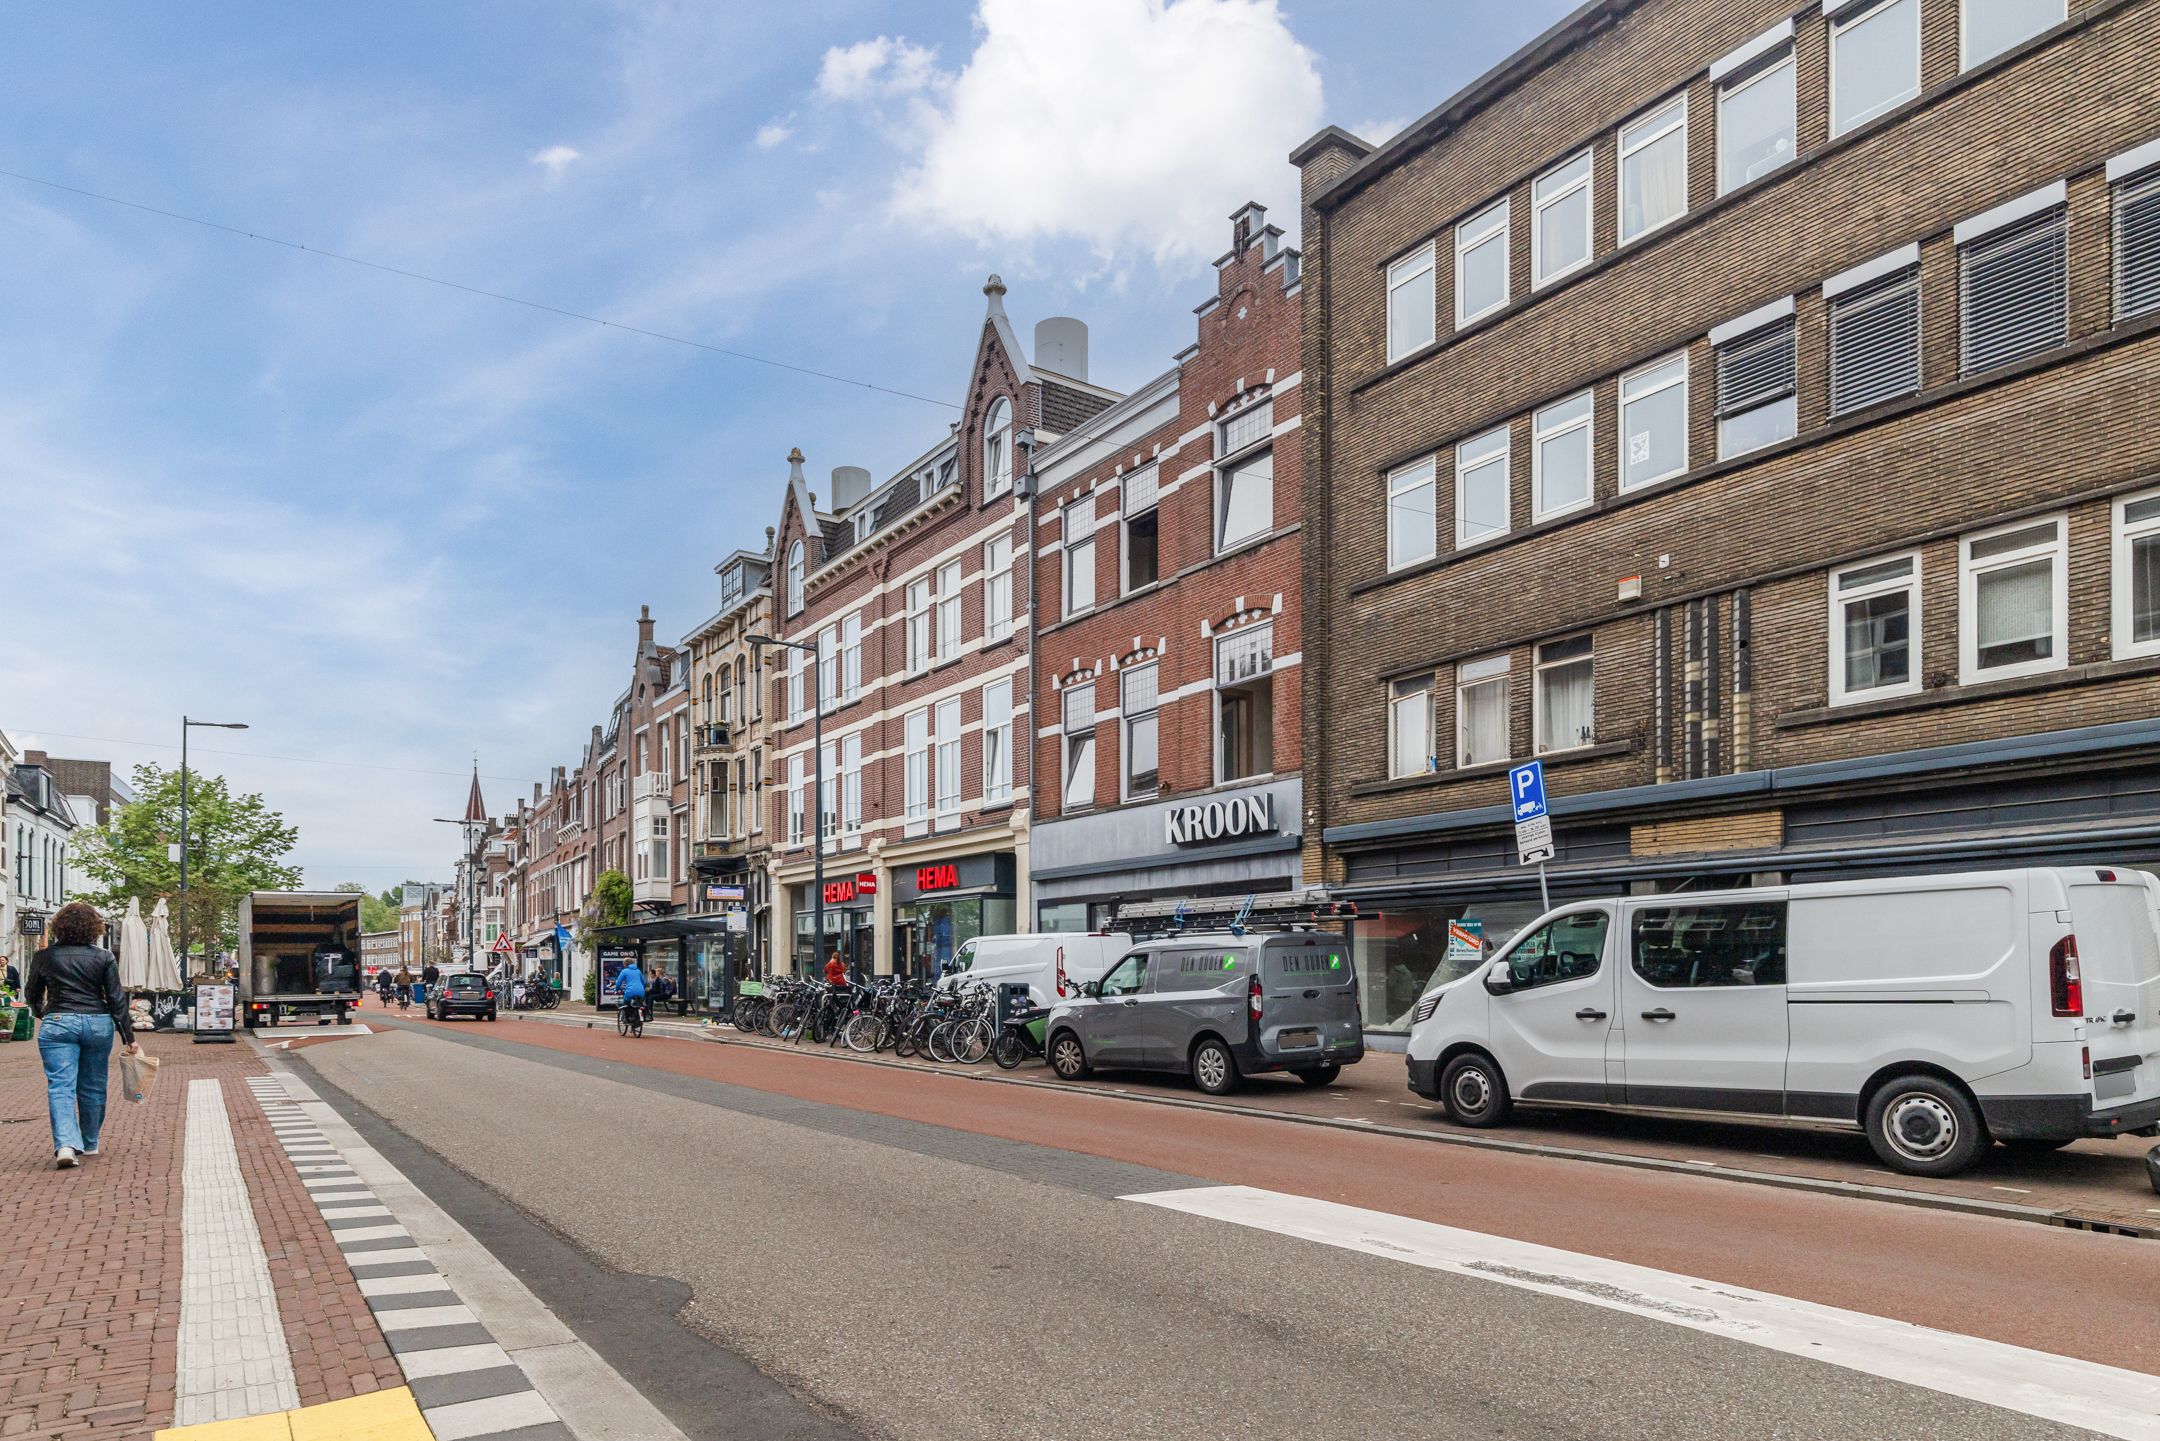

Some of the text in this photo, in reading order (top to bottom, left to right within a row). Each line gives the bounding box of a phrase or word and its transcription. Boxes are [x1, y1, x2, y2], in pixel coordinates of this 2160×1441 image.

[1517, 769, 1534, 798] P
[1165, 793, 1270, 844] KROON
[917, 864, 959, 890] HEMA
[823, 881, 855, 903] HEMA
